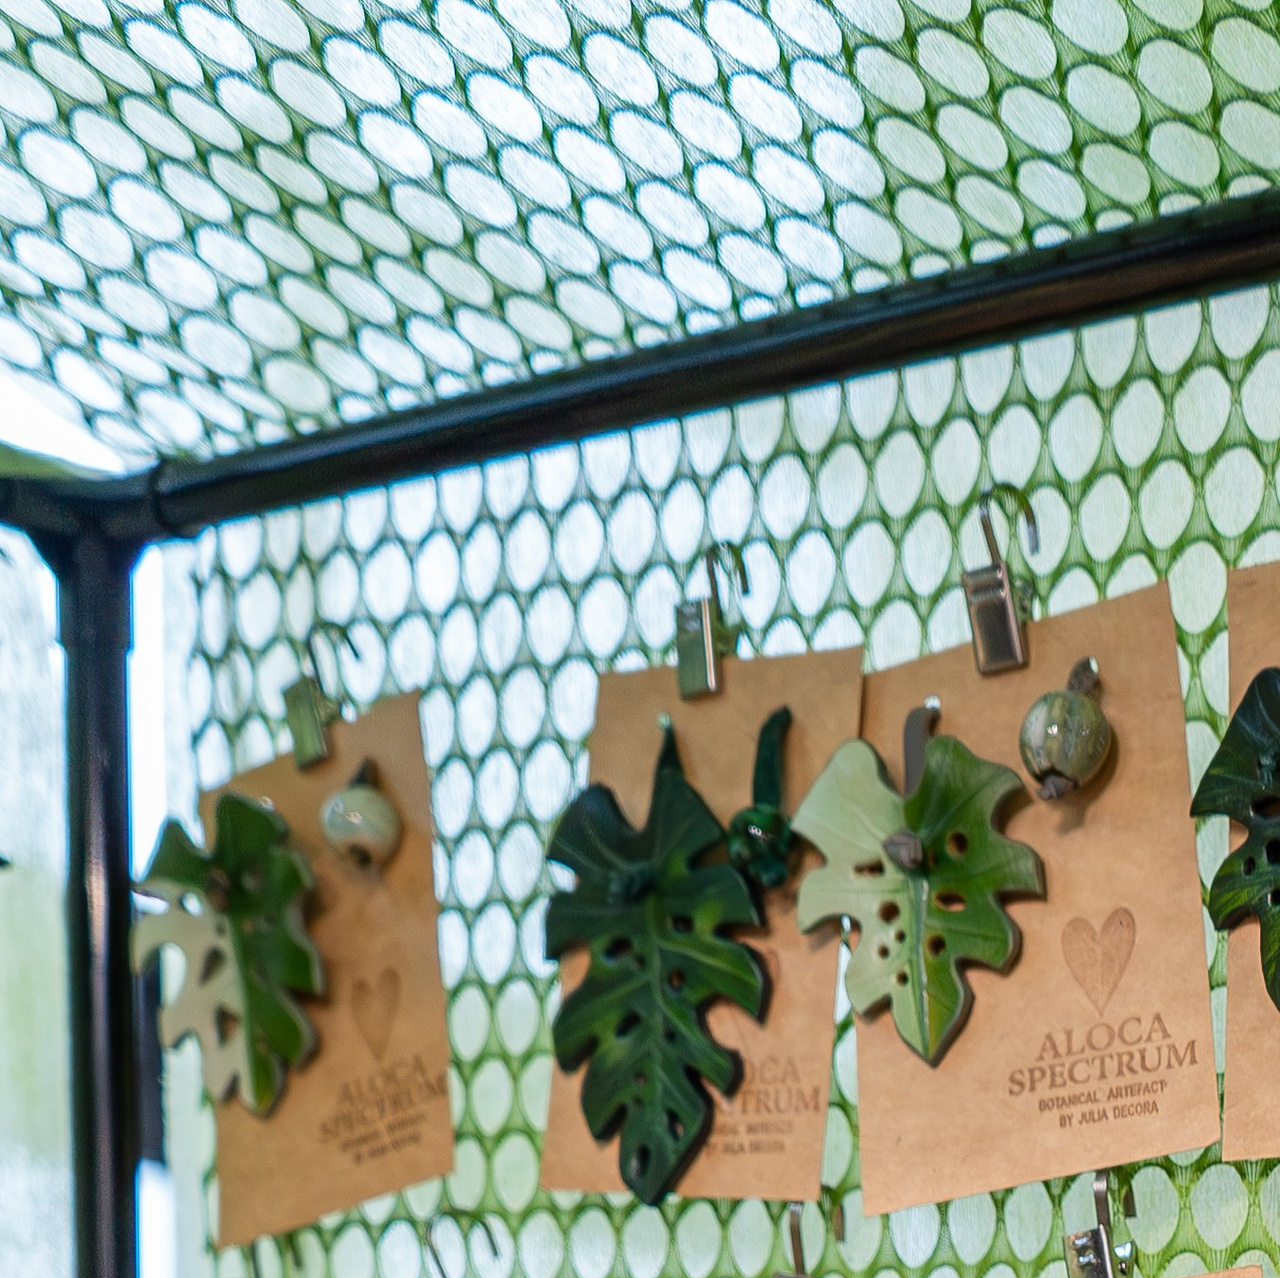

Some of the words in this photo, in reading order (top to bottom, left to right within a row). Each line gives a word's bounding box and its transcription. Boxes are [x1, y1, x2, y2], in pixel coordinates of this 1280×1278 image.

[1036, 1012, 1171, 1061] ALOCA
[1008, 1040, 1198, 1096] SPECTRUM
[1039, 1090, 1099, 1113] BOTANICAL
[1060, 1115, 1073, 1128] BY
[1079, 1108, 1109, 1125] JULIA
[1114, 1101, 1158, 1119] DECORA
